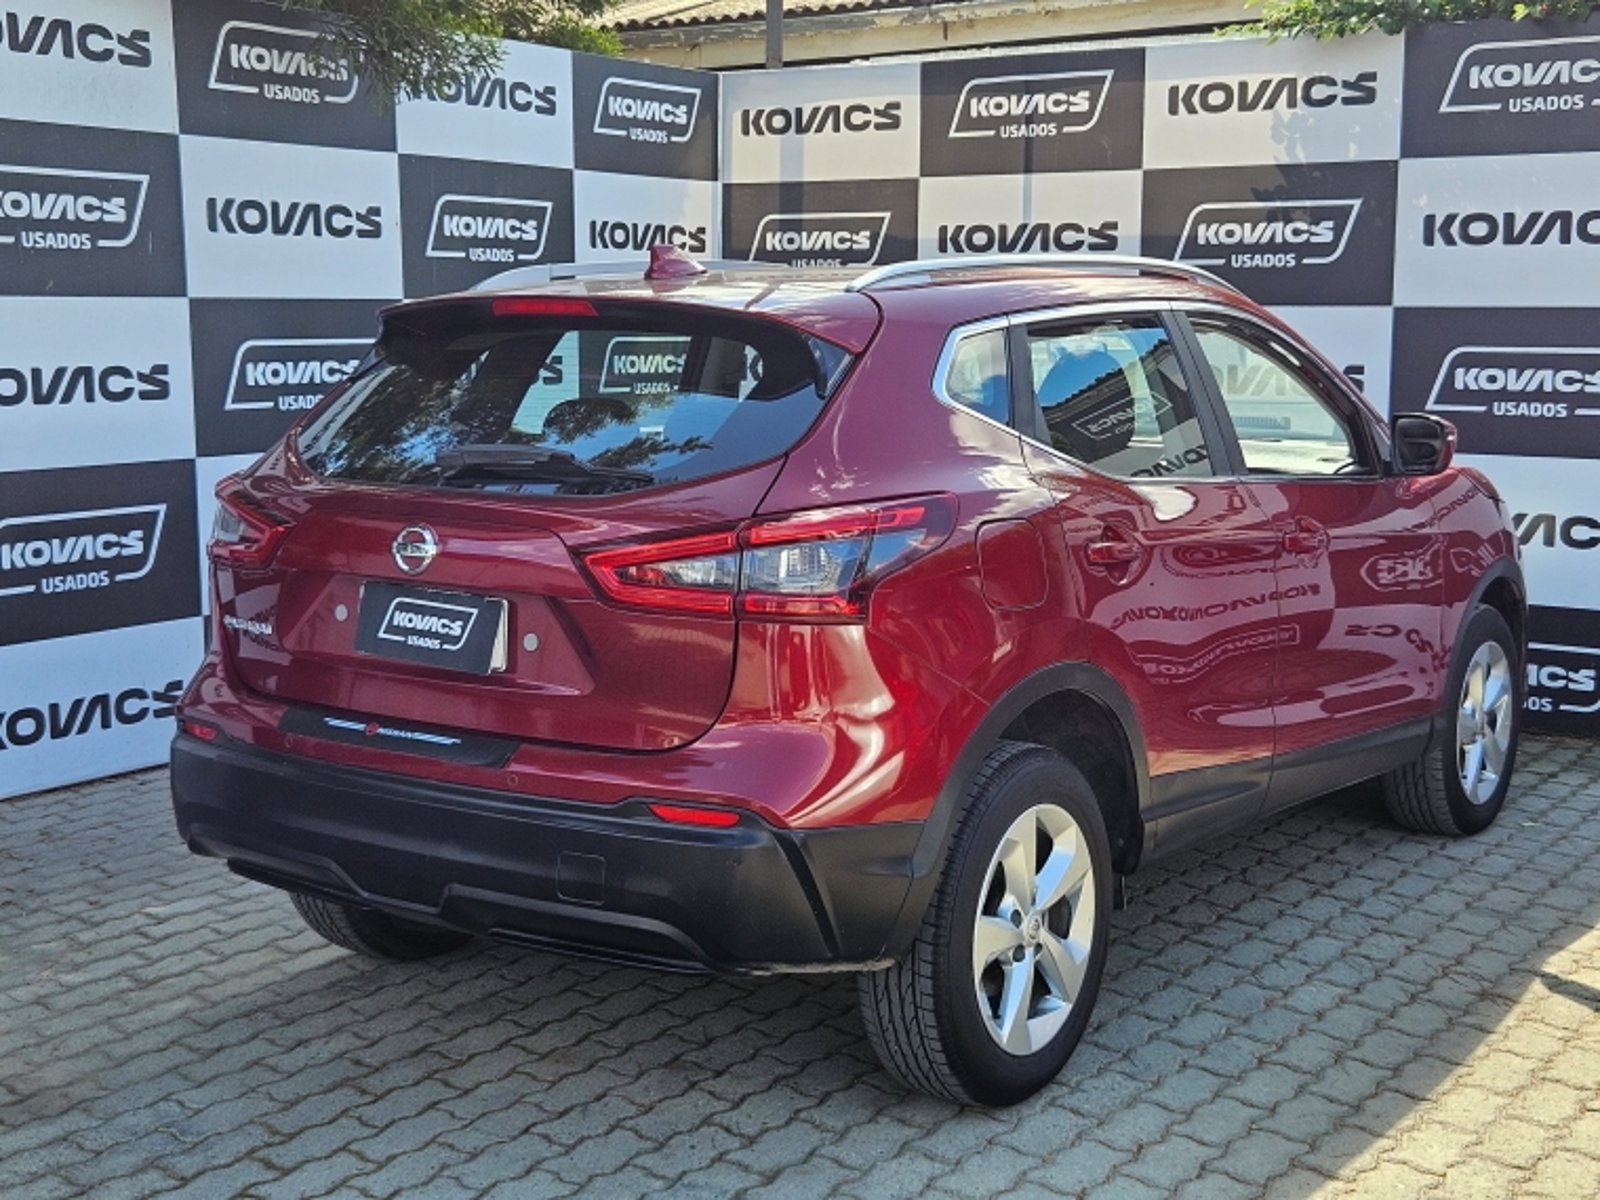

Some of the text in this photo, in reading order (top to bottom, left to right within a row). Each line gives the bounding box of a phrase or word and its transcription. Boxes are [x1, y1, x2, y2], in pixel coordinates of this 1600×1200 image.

[0, 12, 152, 67] VACS
[1469, 58, 1600, 89] KOVAC
[263, 83, 320, 104] USADOS
[969, 90, 1091, 118] KOVACS
[1168, 71, 1377, 116] KOVACS
[1508, 94, 1584, 113] USADOS
[608, 96, 687, 125] KOVACS
[741, 101, 901, 136] KOVACS
[629, 127, 668, 143] USADOS
[1000, 123, 1058, 139] USADOS
[206, 197, 382, 238] KOVACS
[443, 214, 538, 241] KOVACS
[1423, 210, 1600, 247] KOVAC
[21, 231, 92, 249] USADOS
[589, 220, 706, 253] KOVACS
[765, 230, 871, 252] KOVACS
[938, 221, 1119, 254] KOVACS
[1197, 220, 1334, 246] KOVACS
[469, 248, 514, 262] USADOS
[1231, 253, 1296, 268] USADOS
[0, 363, 170, 406] OVACS
[278, 395, 325, 410] USAD
[1493, 401, 1568, 418] USADOS
[1, 530, 144, 569] KOVACS
[41, 570, 110, 594] USADOS
[393, 610, 463, 636] KOVACS
